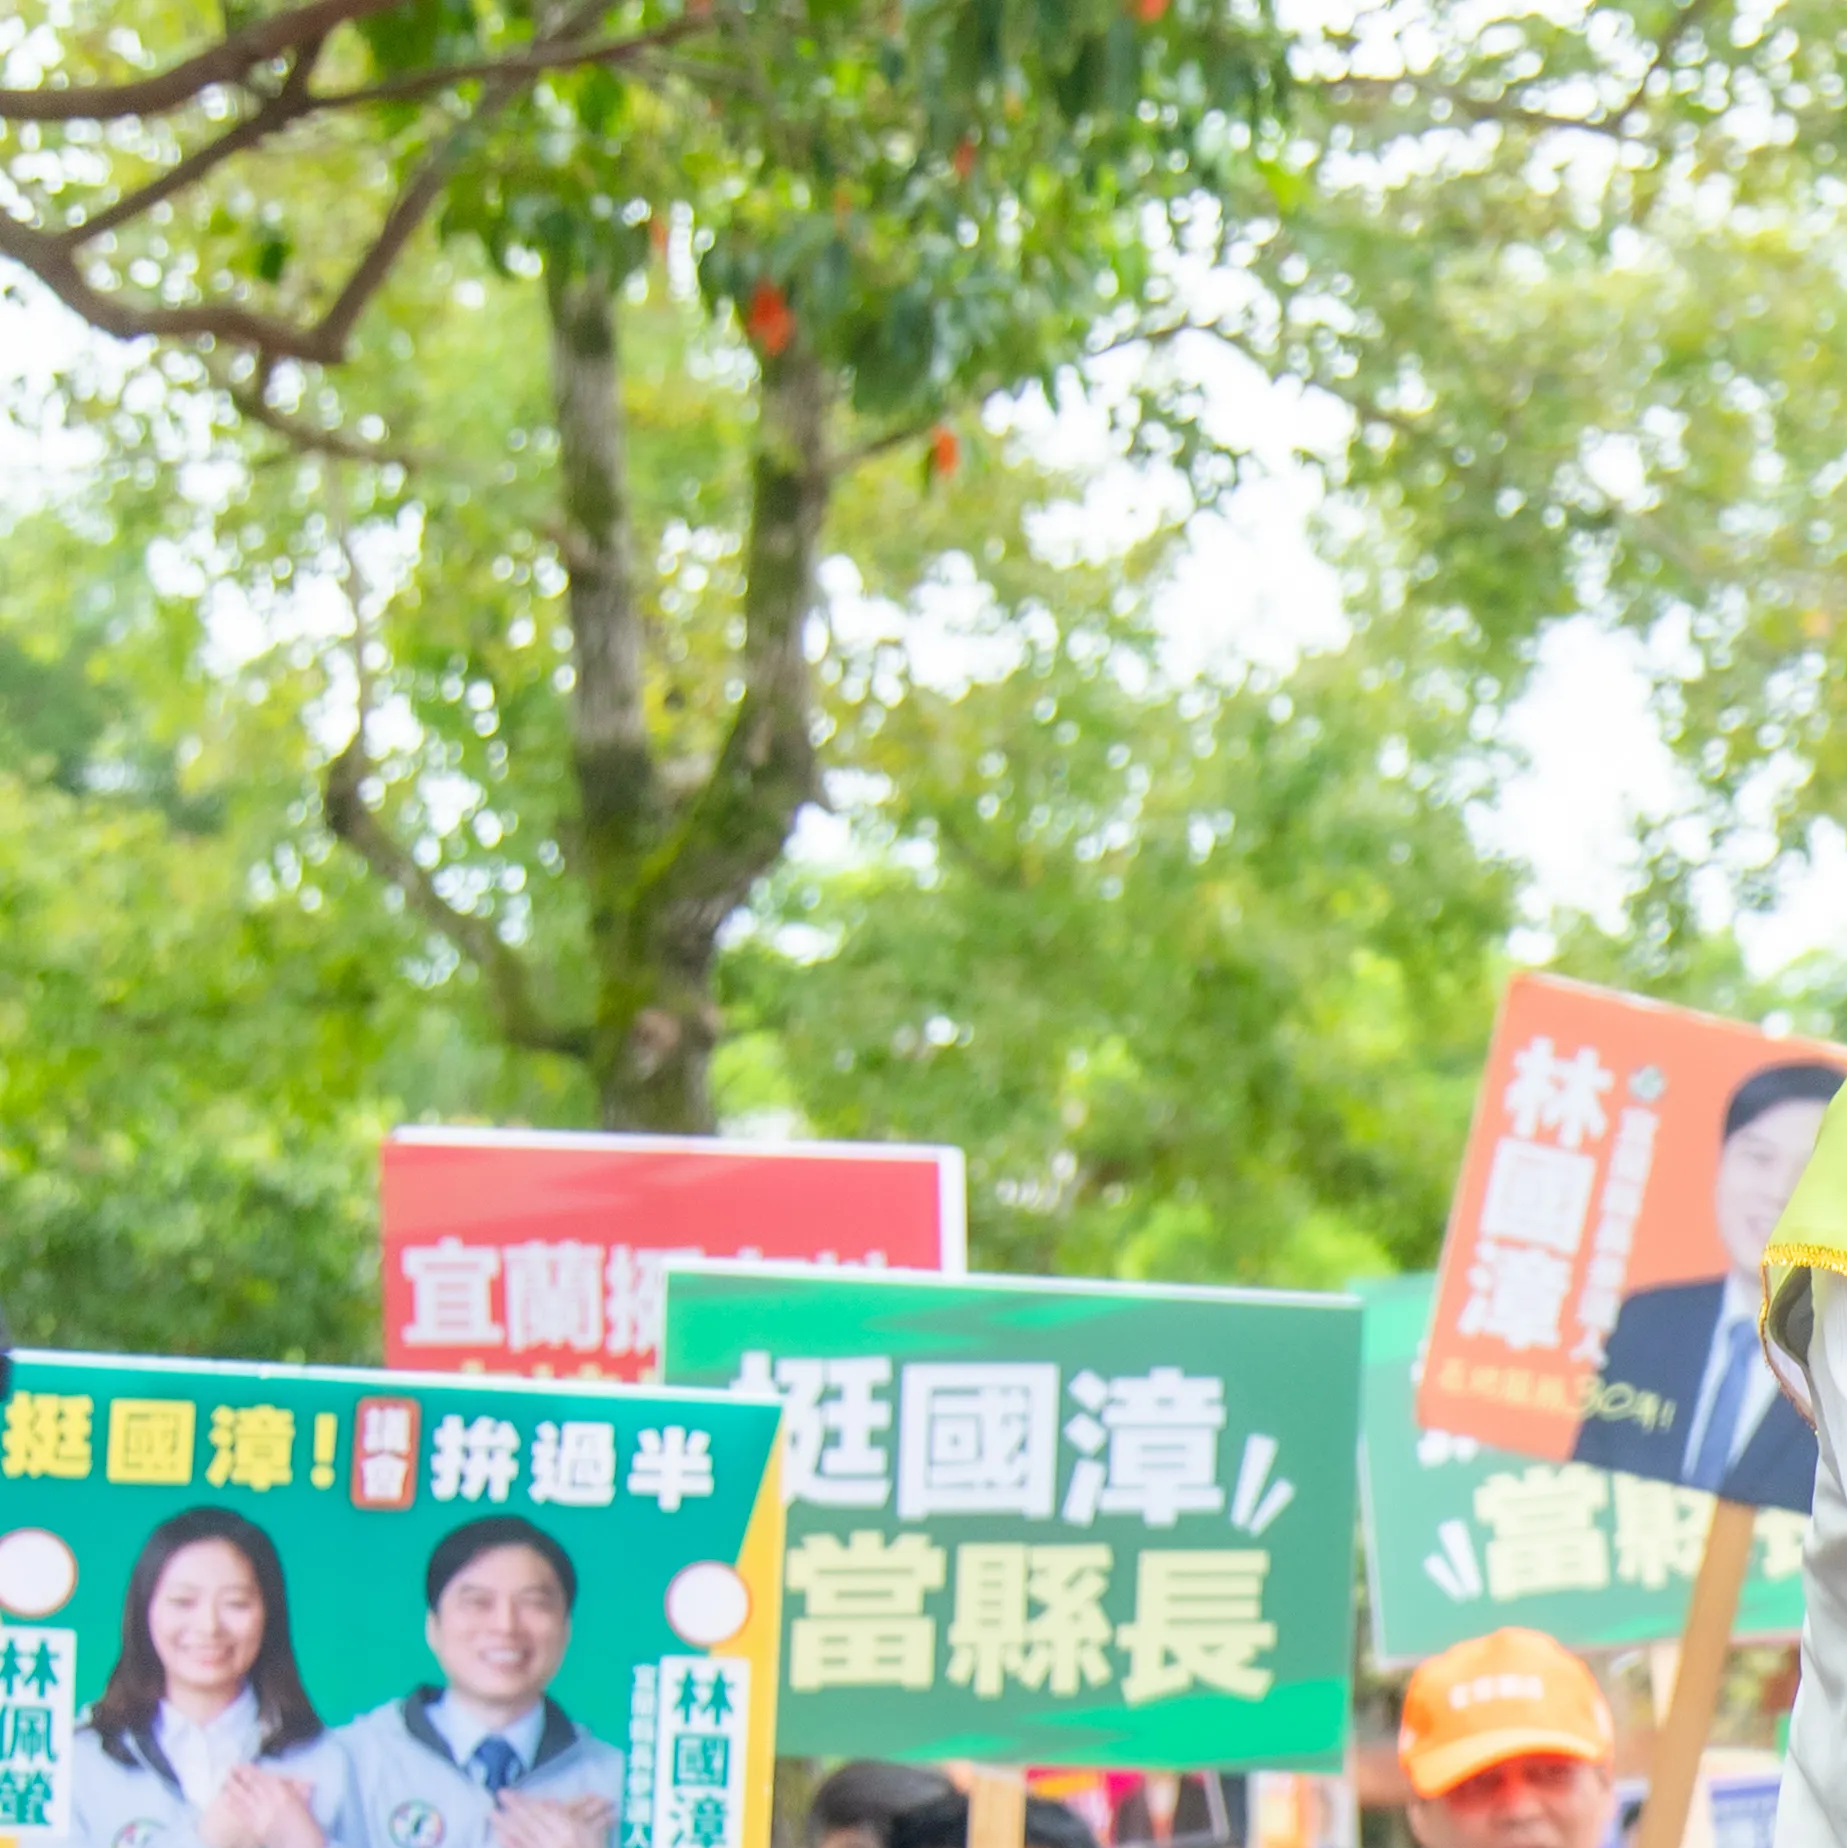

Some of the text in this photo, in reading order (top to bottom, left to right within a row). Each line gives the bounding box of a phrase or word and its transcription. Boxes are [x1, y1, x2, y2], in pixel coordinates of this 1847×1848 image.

[2, 1390, 338, 1491] 挺國漳!
[785, 1529, 1278, 1705] 當縣長
